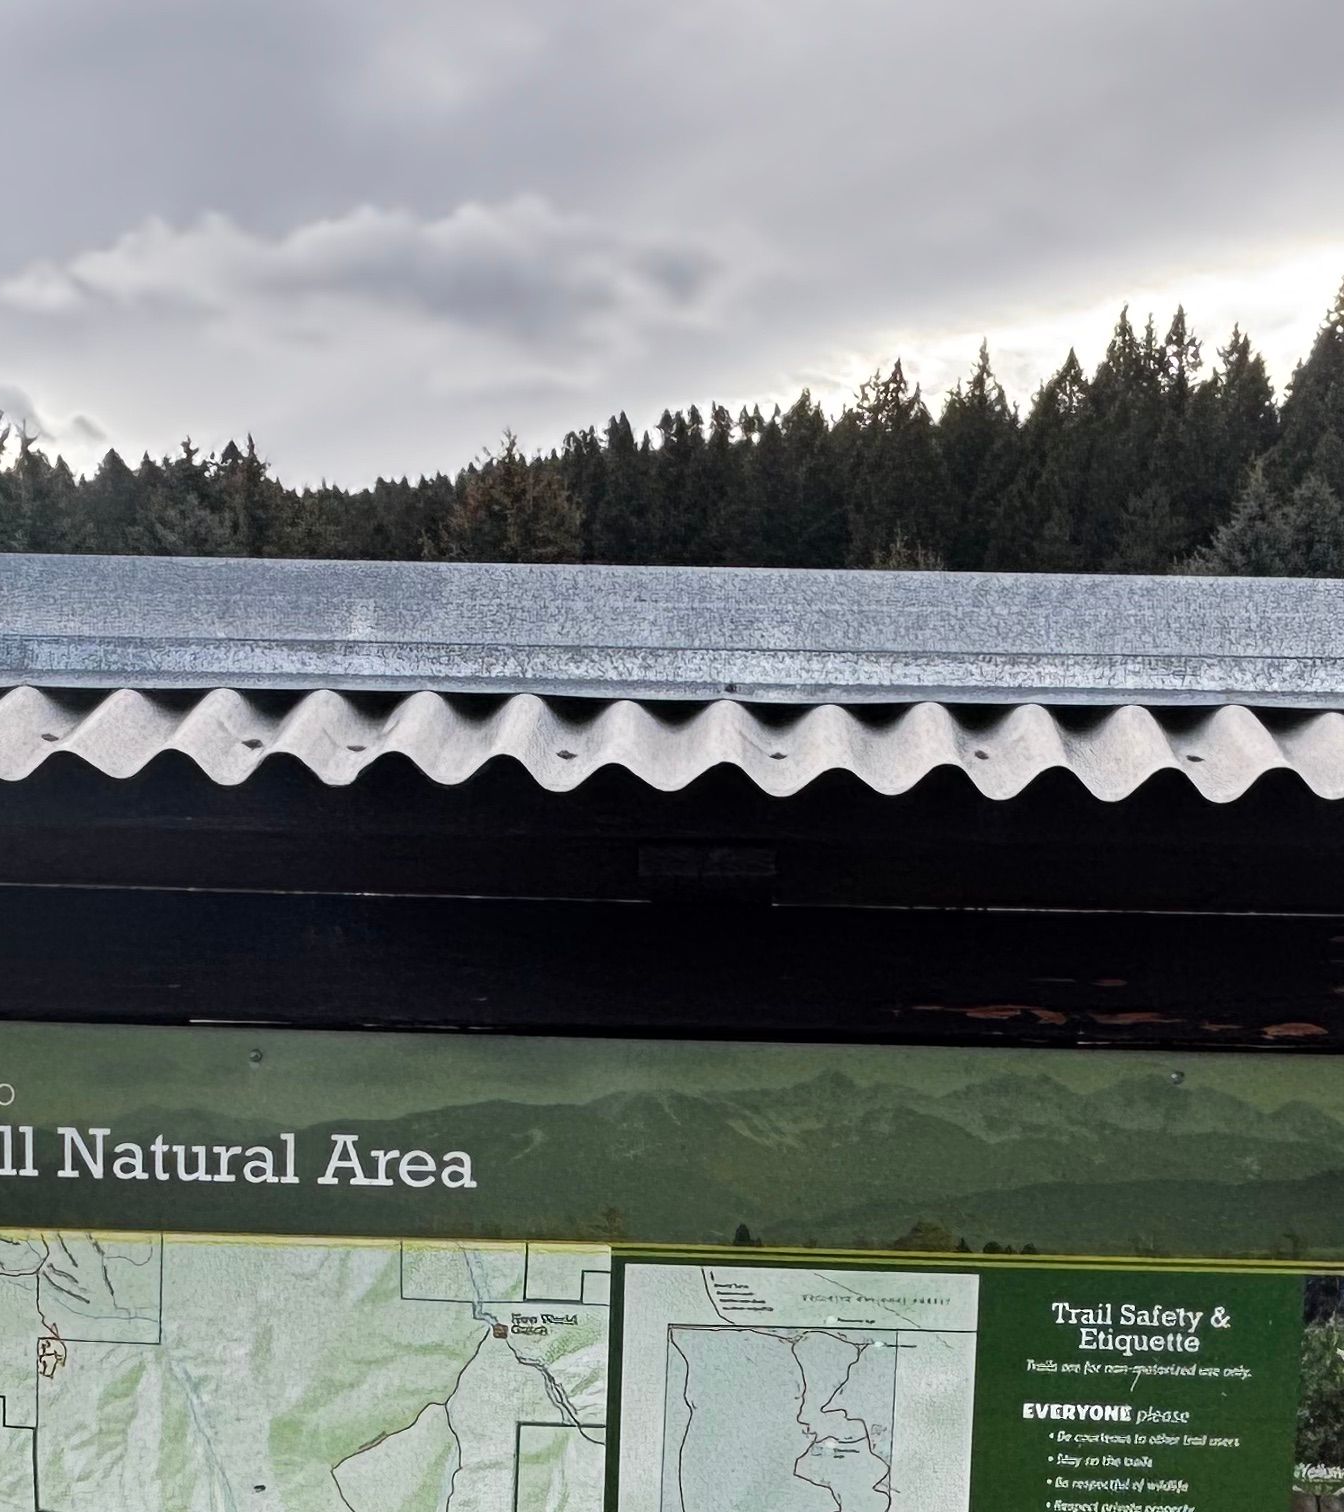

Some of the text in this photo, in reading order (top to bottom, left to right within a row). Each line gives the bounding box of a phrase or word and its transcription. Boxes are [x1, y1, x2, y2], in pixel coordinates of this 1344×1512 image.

[57, 1126, 300, 1184] Natural
[317, 1134, 478, 1188] Area
[1052, 1303, 1230, 1332] Trail Safety &
[1079, 1328, 1200, 1356] Etiquette
[1022, 1403, 1190, 1424] EVERYONE please
